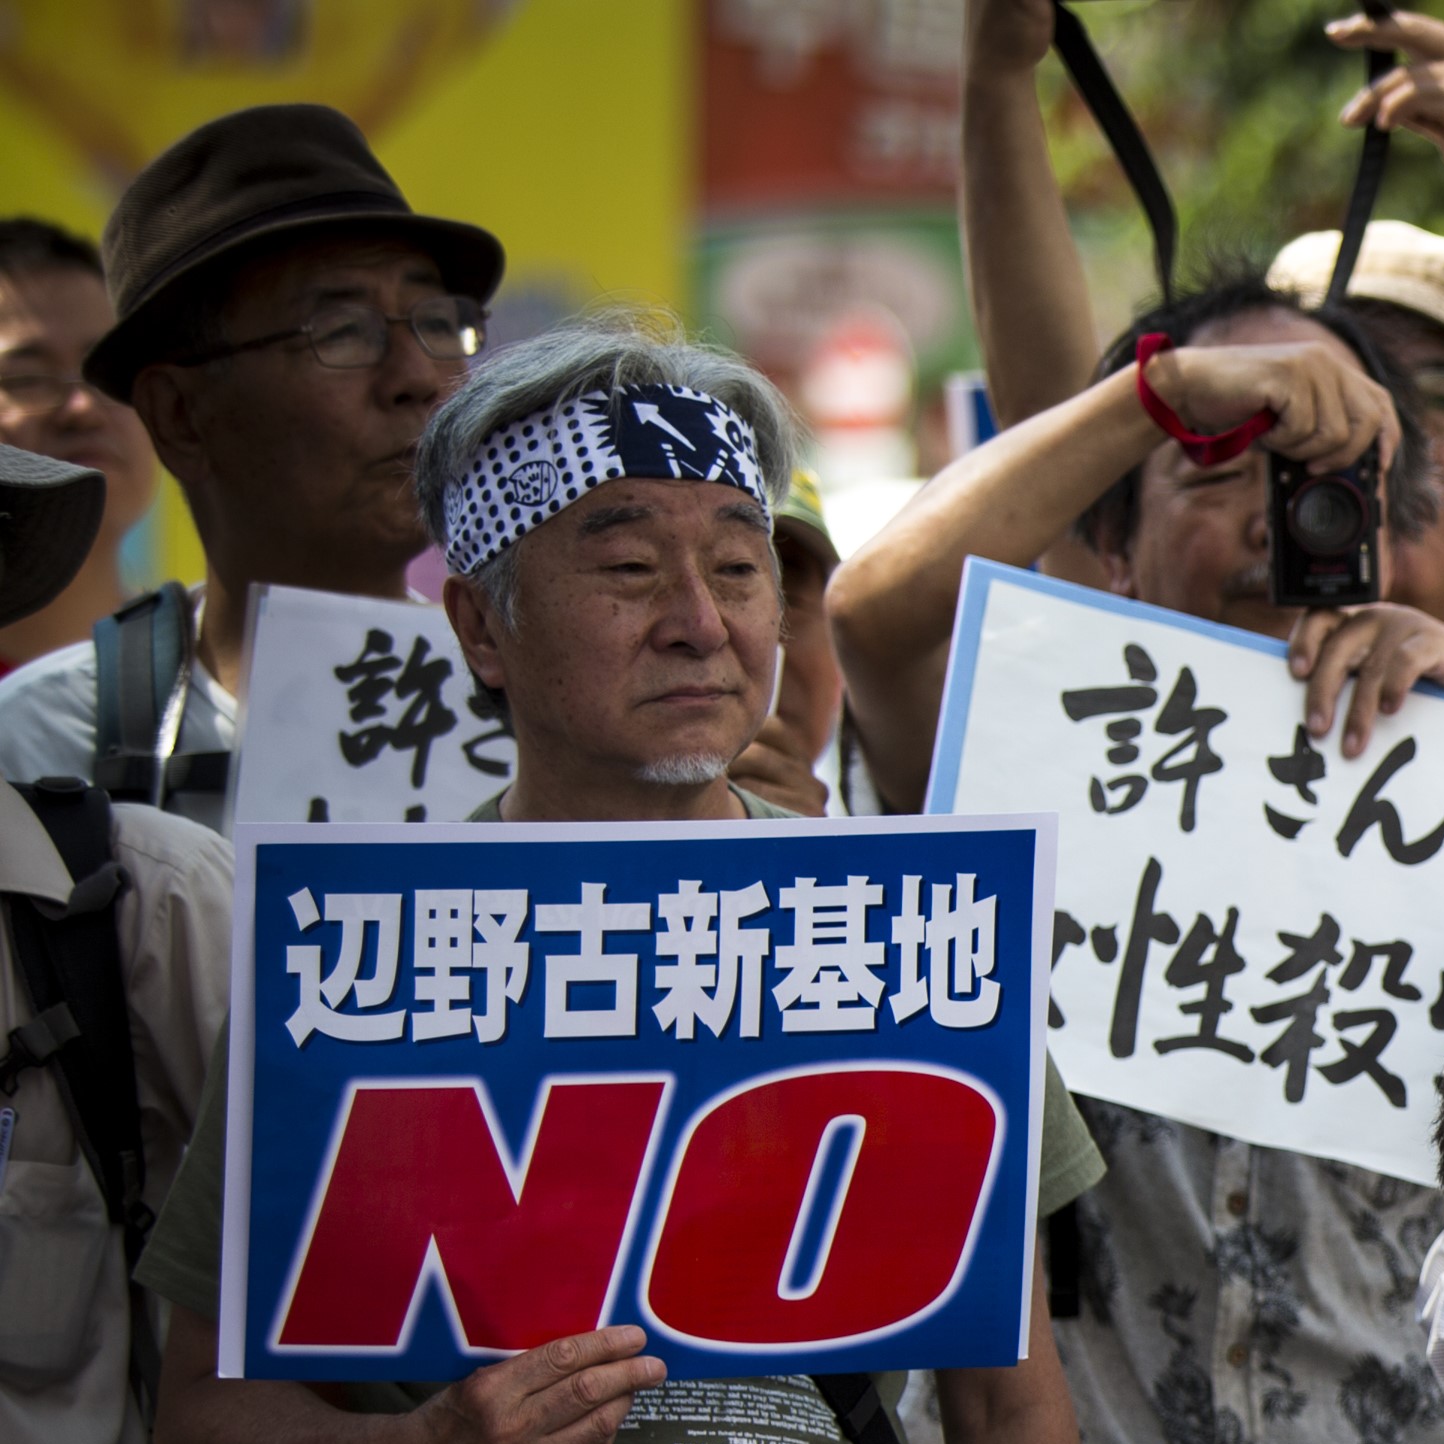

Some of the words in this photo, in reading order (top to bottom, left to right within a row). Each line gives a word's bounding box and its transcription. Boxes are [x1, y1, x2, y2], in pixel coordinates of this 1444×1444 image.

[284, 872, 1003, 1048] 辺野古新基地
[267, 1060, 1007, 1357] NO
